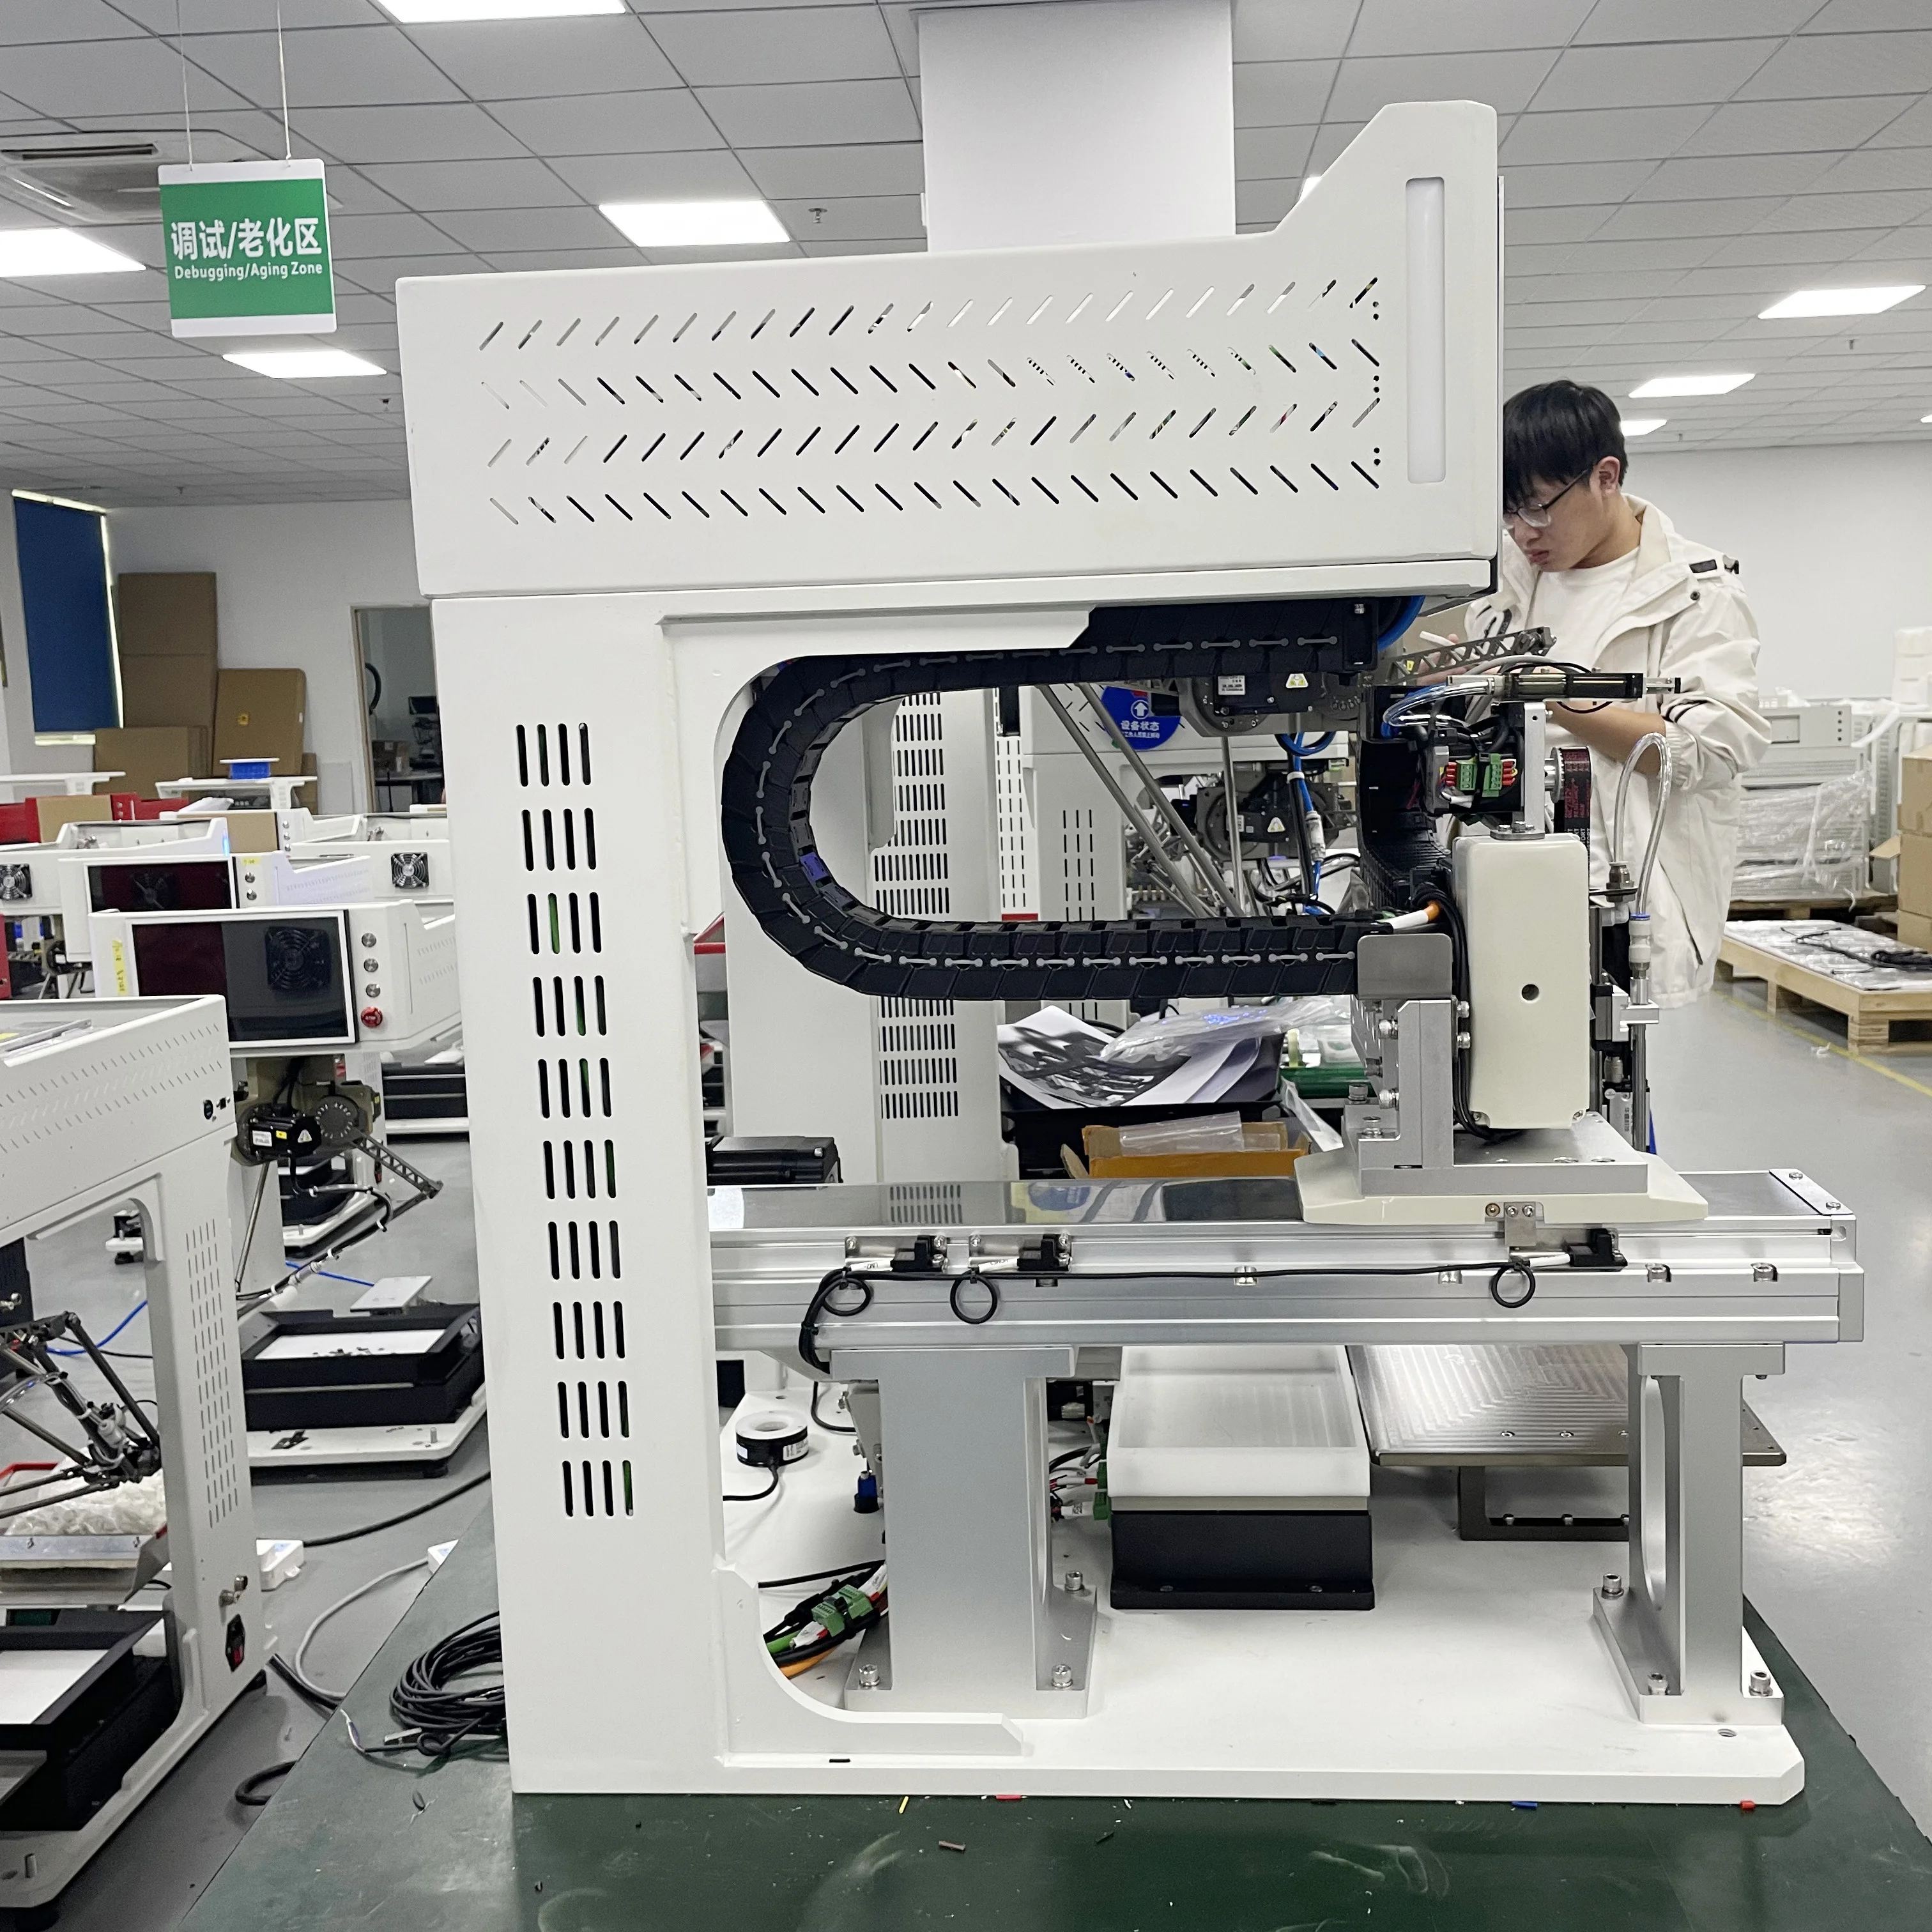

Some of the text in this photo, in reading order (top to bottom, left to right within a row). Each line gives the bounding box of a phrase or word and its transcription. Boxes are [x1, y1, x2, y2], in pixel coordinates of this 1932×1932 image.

[171, 217, 322, 260] 调试/老化区
[174, 261, 323, 282] Debugging/Aging Zone
[1121, 720, 1160, 731] 设备状态
